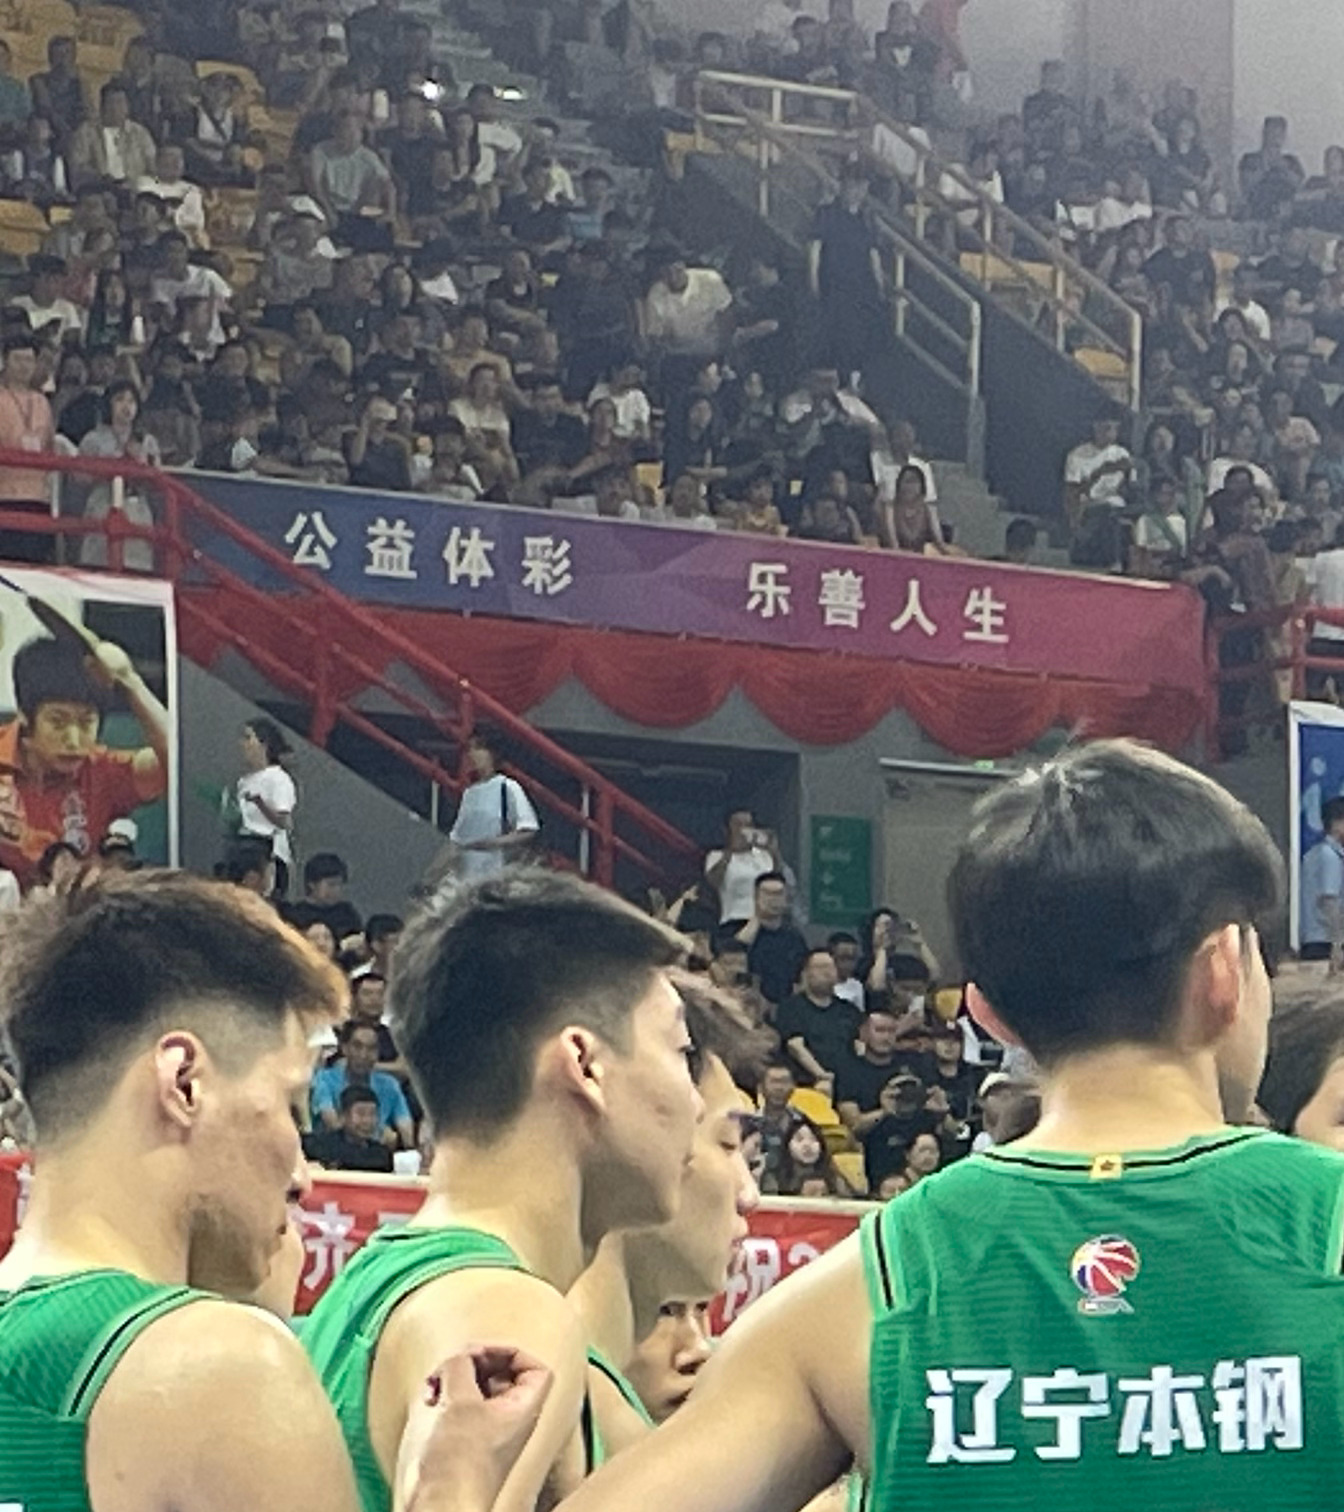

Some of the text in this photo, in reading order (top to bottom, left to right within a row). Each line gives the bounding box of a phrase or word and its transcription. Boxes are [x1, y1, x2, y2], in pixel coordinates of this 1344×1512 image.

[285, 511, 1009, 644] 公益体彩 乐善人生
[925, 1354, 1305, 1464] 辽宁本钢
